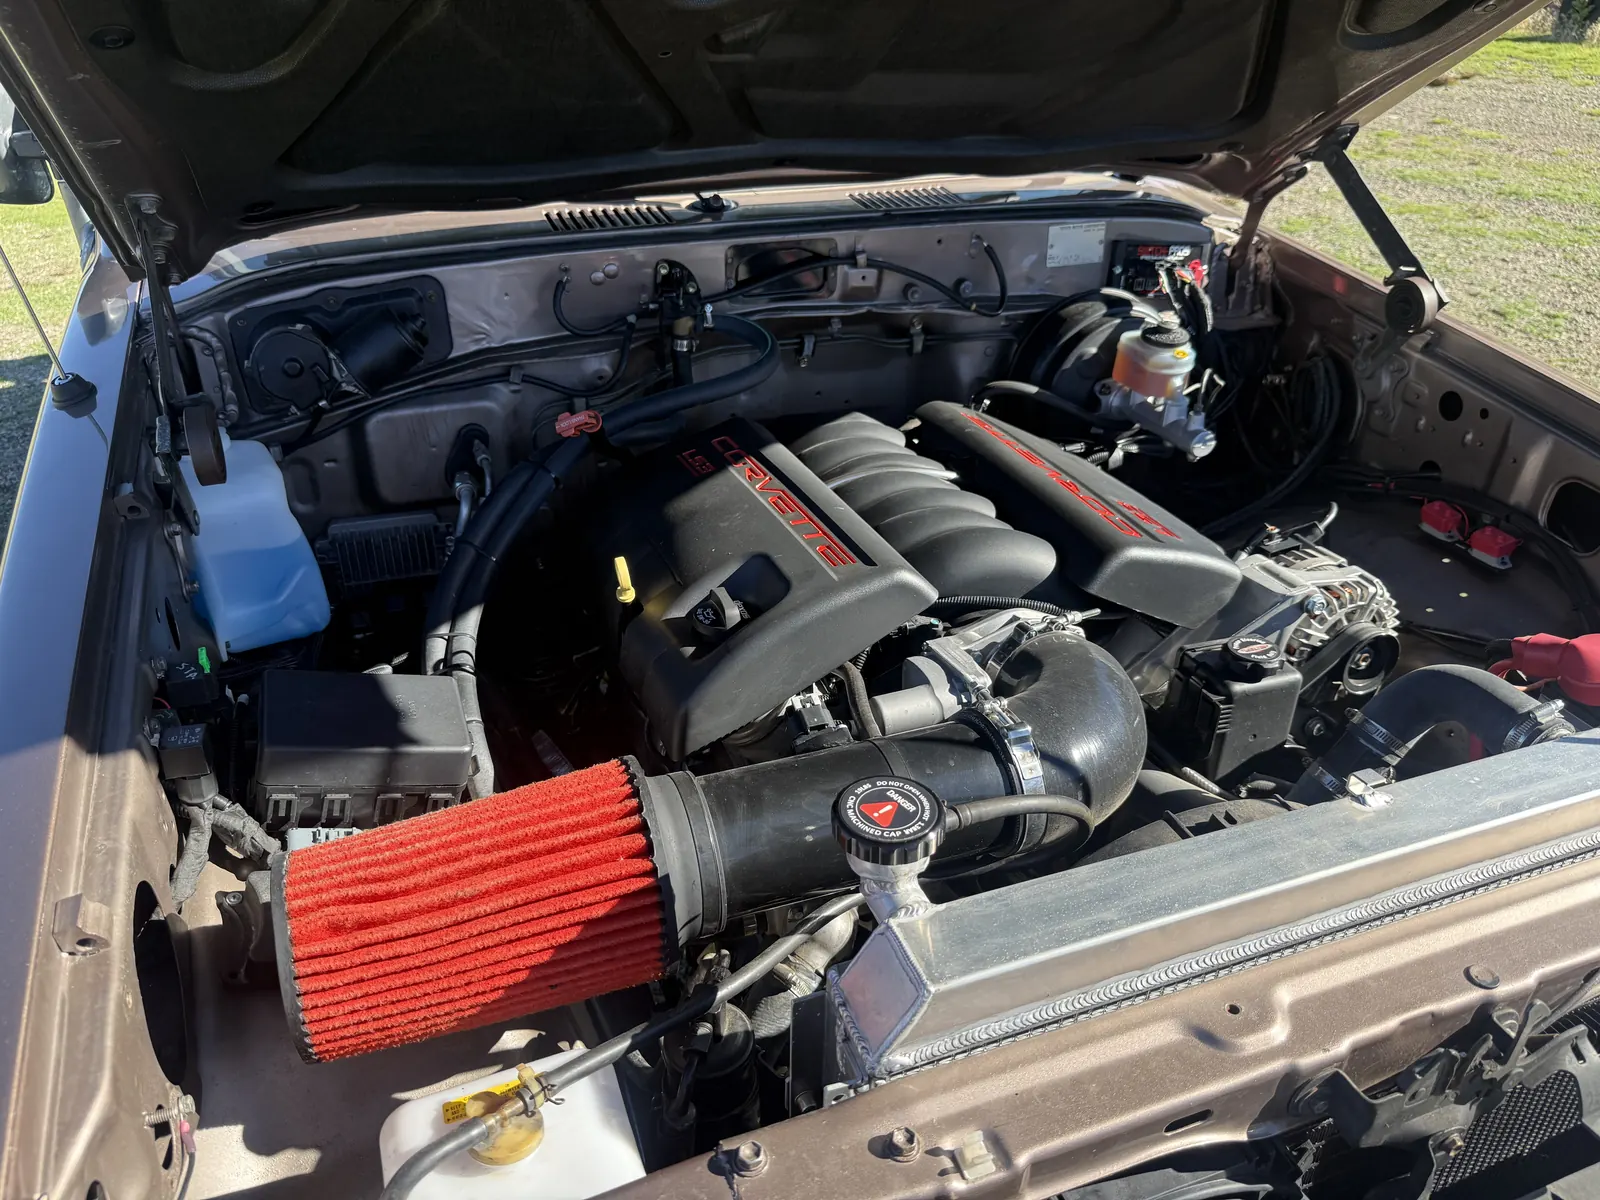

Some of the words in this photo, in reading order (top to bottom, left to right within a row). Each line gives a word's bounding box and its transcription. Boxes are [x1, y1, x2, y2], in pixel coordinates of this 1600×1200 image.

[711, 436, 857, 567] CORVETTE
[846, 795, 856, 809] CNC
[886, 789, 916, 812] DANGER
[904, 784, 920, 797] OPEN
[846, 808, 882, 836] MACHINED
